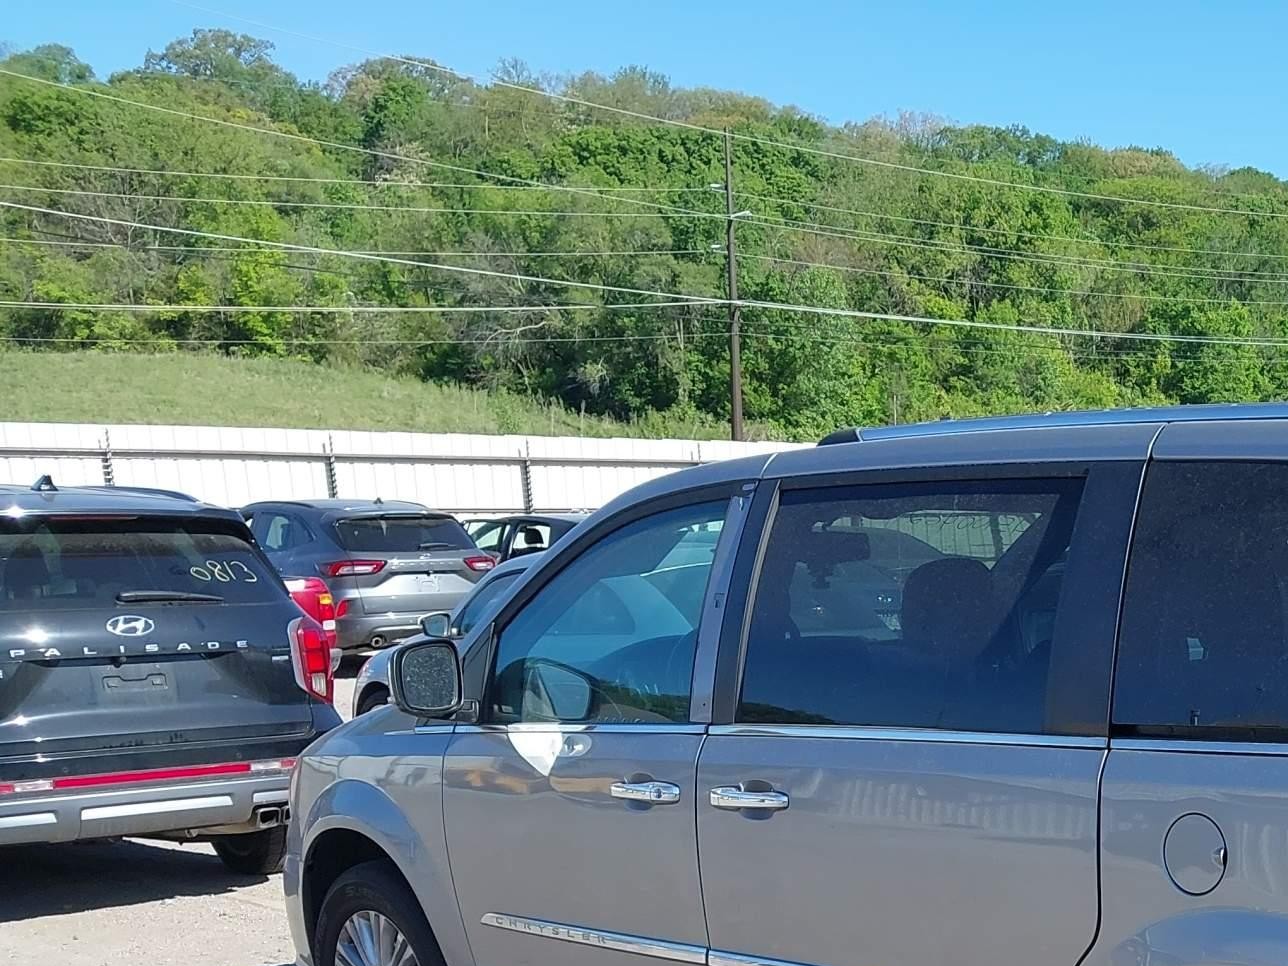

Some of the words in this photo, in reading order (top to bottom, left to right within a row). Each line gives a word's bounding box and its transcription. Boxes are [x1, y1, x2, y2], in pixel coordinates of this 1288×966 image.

[190, 560, 257, 582] 0813
[9, 640, 249, 658] PALISADE
[494, 916, 607, 944] CHRYSLER
